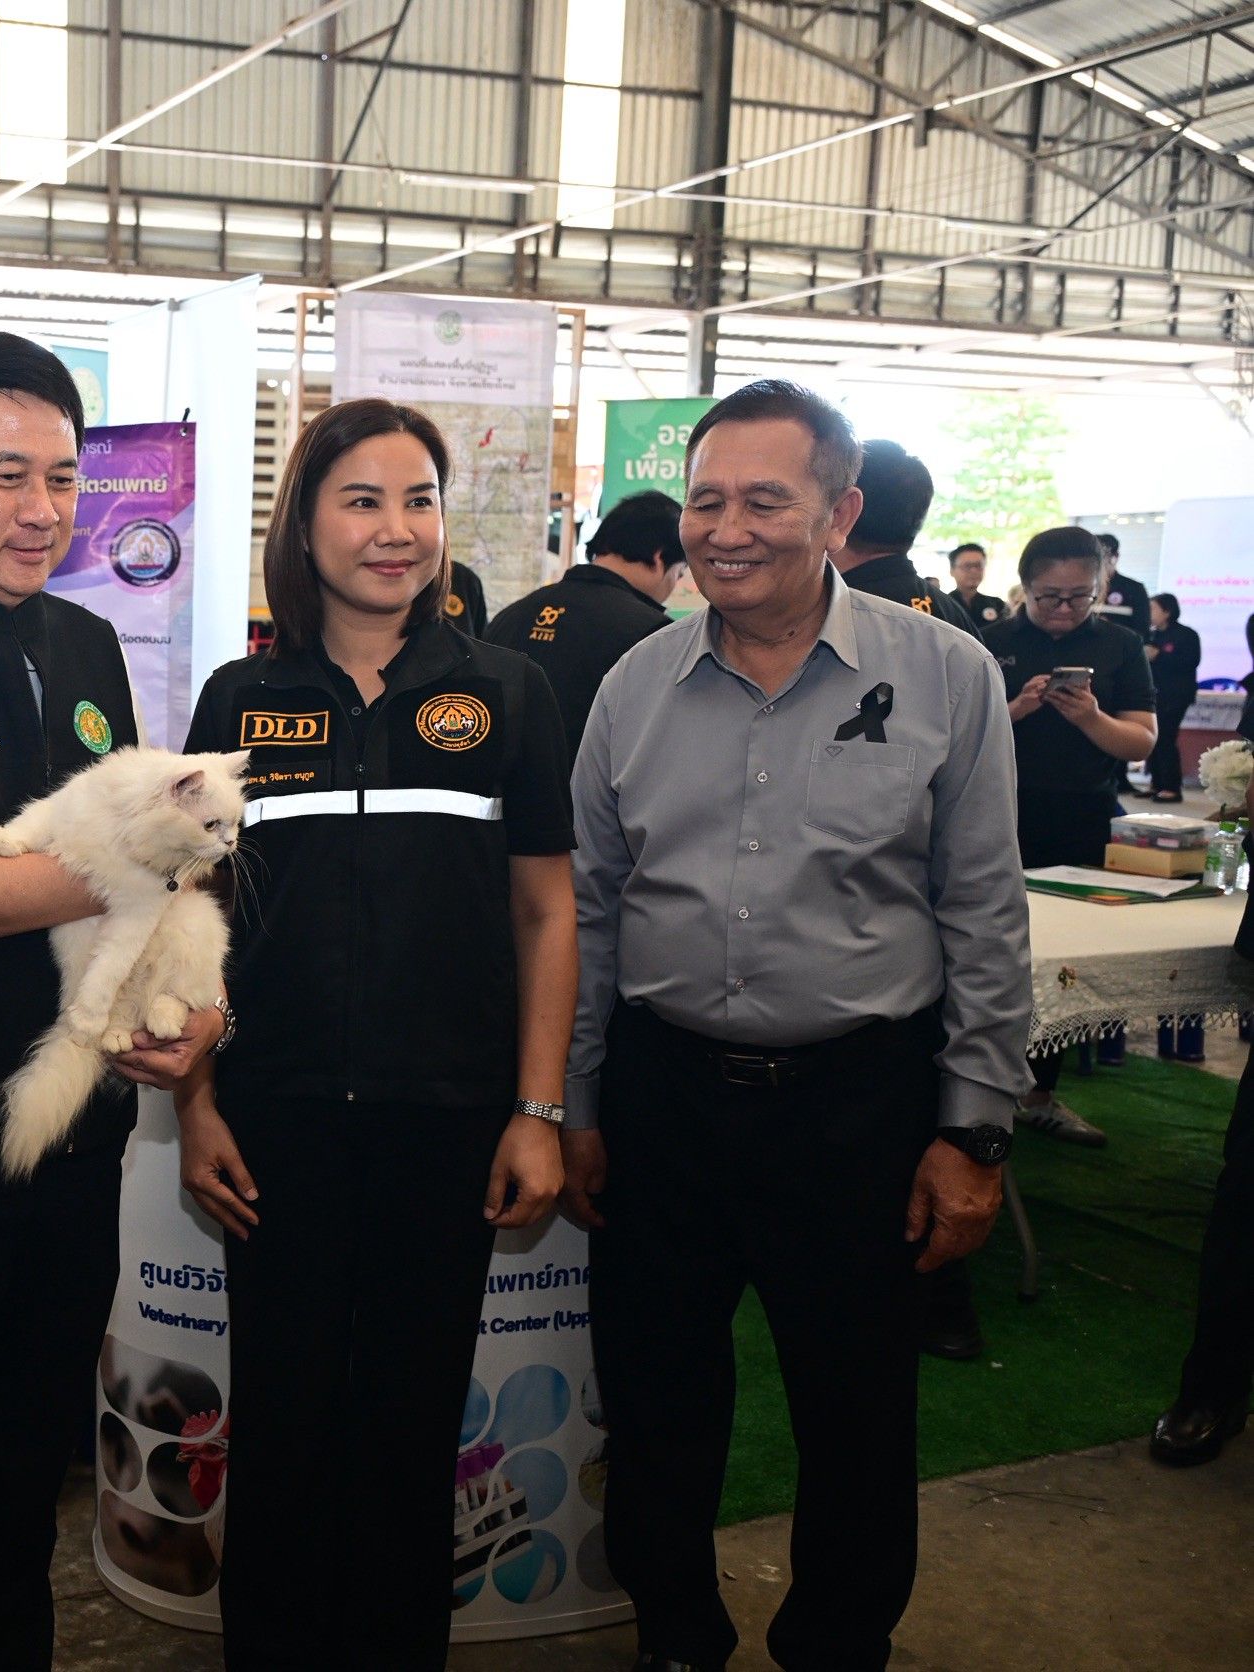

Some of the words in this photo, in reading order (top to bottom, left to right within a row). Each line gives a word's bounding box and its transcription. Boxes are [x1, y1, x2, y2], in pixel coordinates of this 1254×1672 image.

[625, 442, 685, 481] เพื่อ
[251, 716, 317, 739] DLD
[140, 1261, 228, 1293] ศูนย์วิจั
[138, 1300, 228, 1336] Veterinary
[490, 1315, 551, 1333] Center
